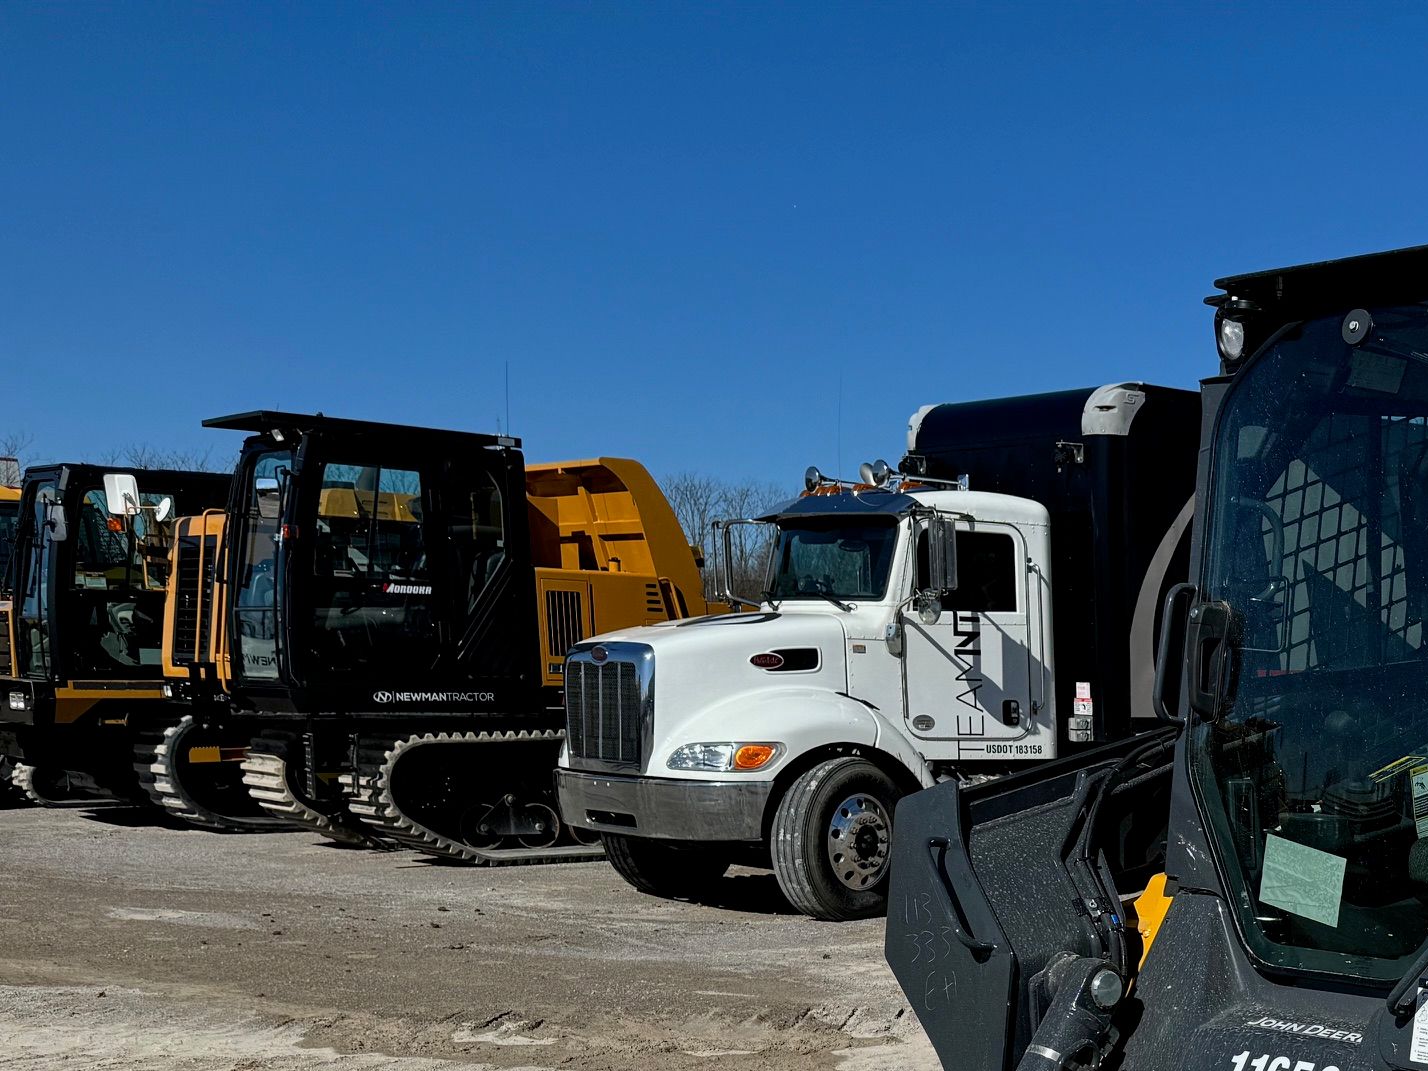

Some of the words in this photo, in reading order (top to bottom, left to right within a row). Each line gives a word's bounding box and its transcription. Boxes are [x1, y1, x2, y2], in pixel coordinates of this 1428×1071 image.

[986, 744, 1013, 754] USDOT
[1015, 744, 1043, 755] 183158
[1247, 1016, 1306, 1034] JOHN
[1302, 1025, 1364, 1043] DEER
